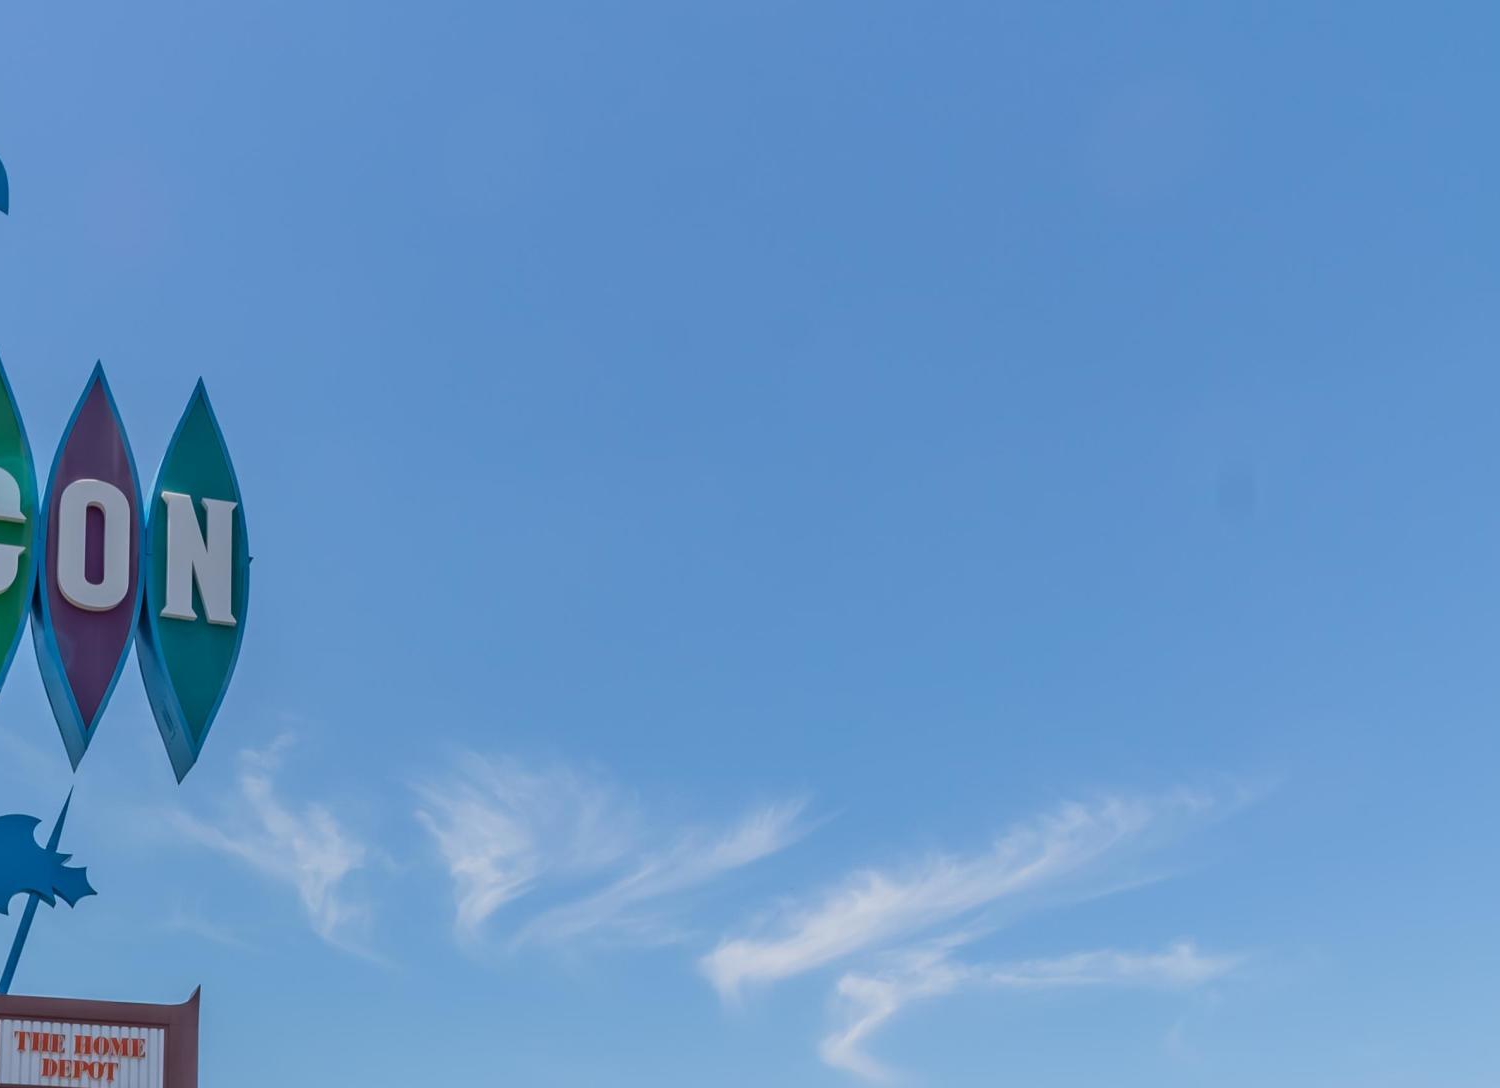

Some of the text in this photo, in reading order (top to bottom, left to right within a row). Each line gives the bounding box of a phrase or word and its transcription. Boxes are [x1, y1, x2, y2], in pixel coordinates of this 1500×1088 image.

[14, 1030, 146, 1058] THE HOME
[41, 1058, 119, 1081] DEPOT
